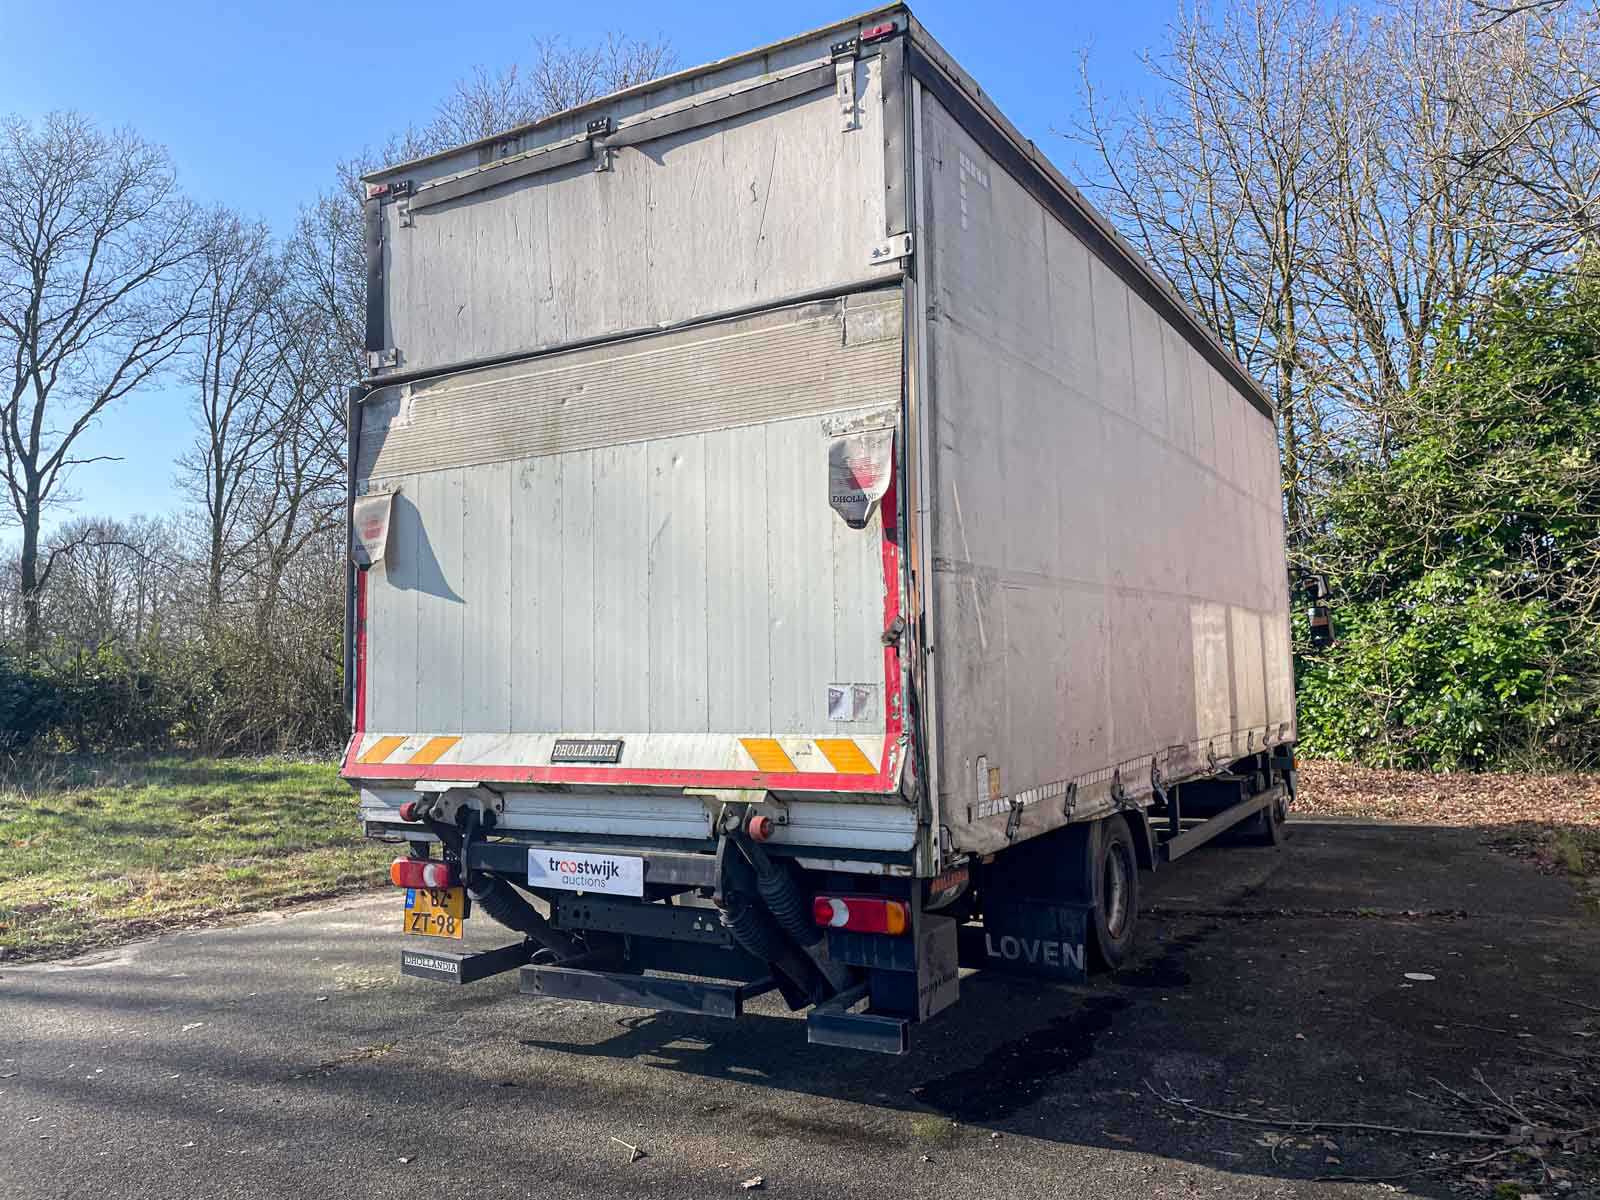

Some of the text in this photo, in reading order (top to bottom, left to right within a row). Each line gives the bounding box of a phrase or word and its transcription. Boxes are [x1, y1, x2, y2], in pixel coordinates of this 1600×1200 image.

[553, 743, 617, 757] DHOLLANDIA
[549, 857, 619, 880] troostwijk
[562, 875, 606, 888] auctions
[412, 912, 455, 934] ZT-98
[985, 932, 1084, 969] LOVEN
[404, 955, 458, 973] DHOLLANDIA
